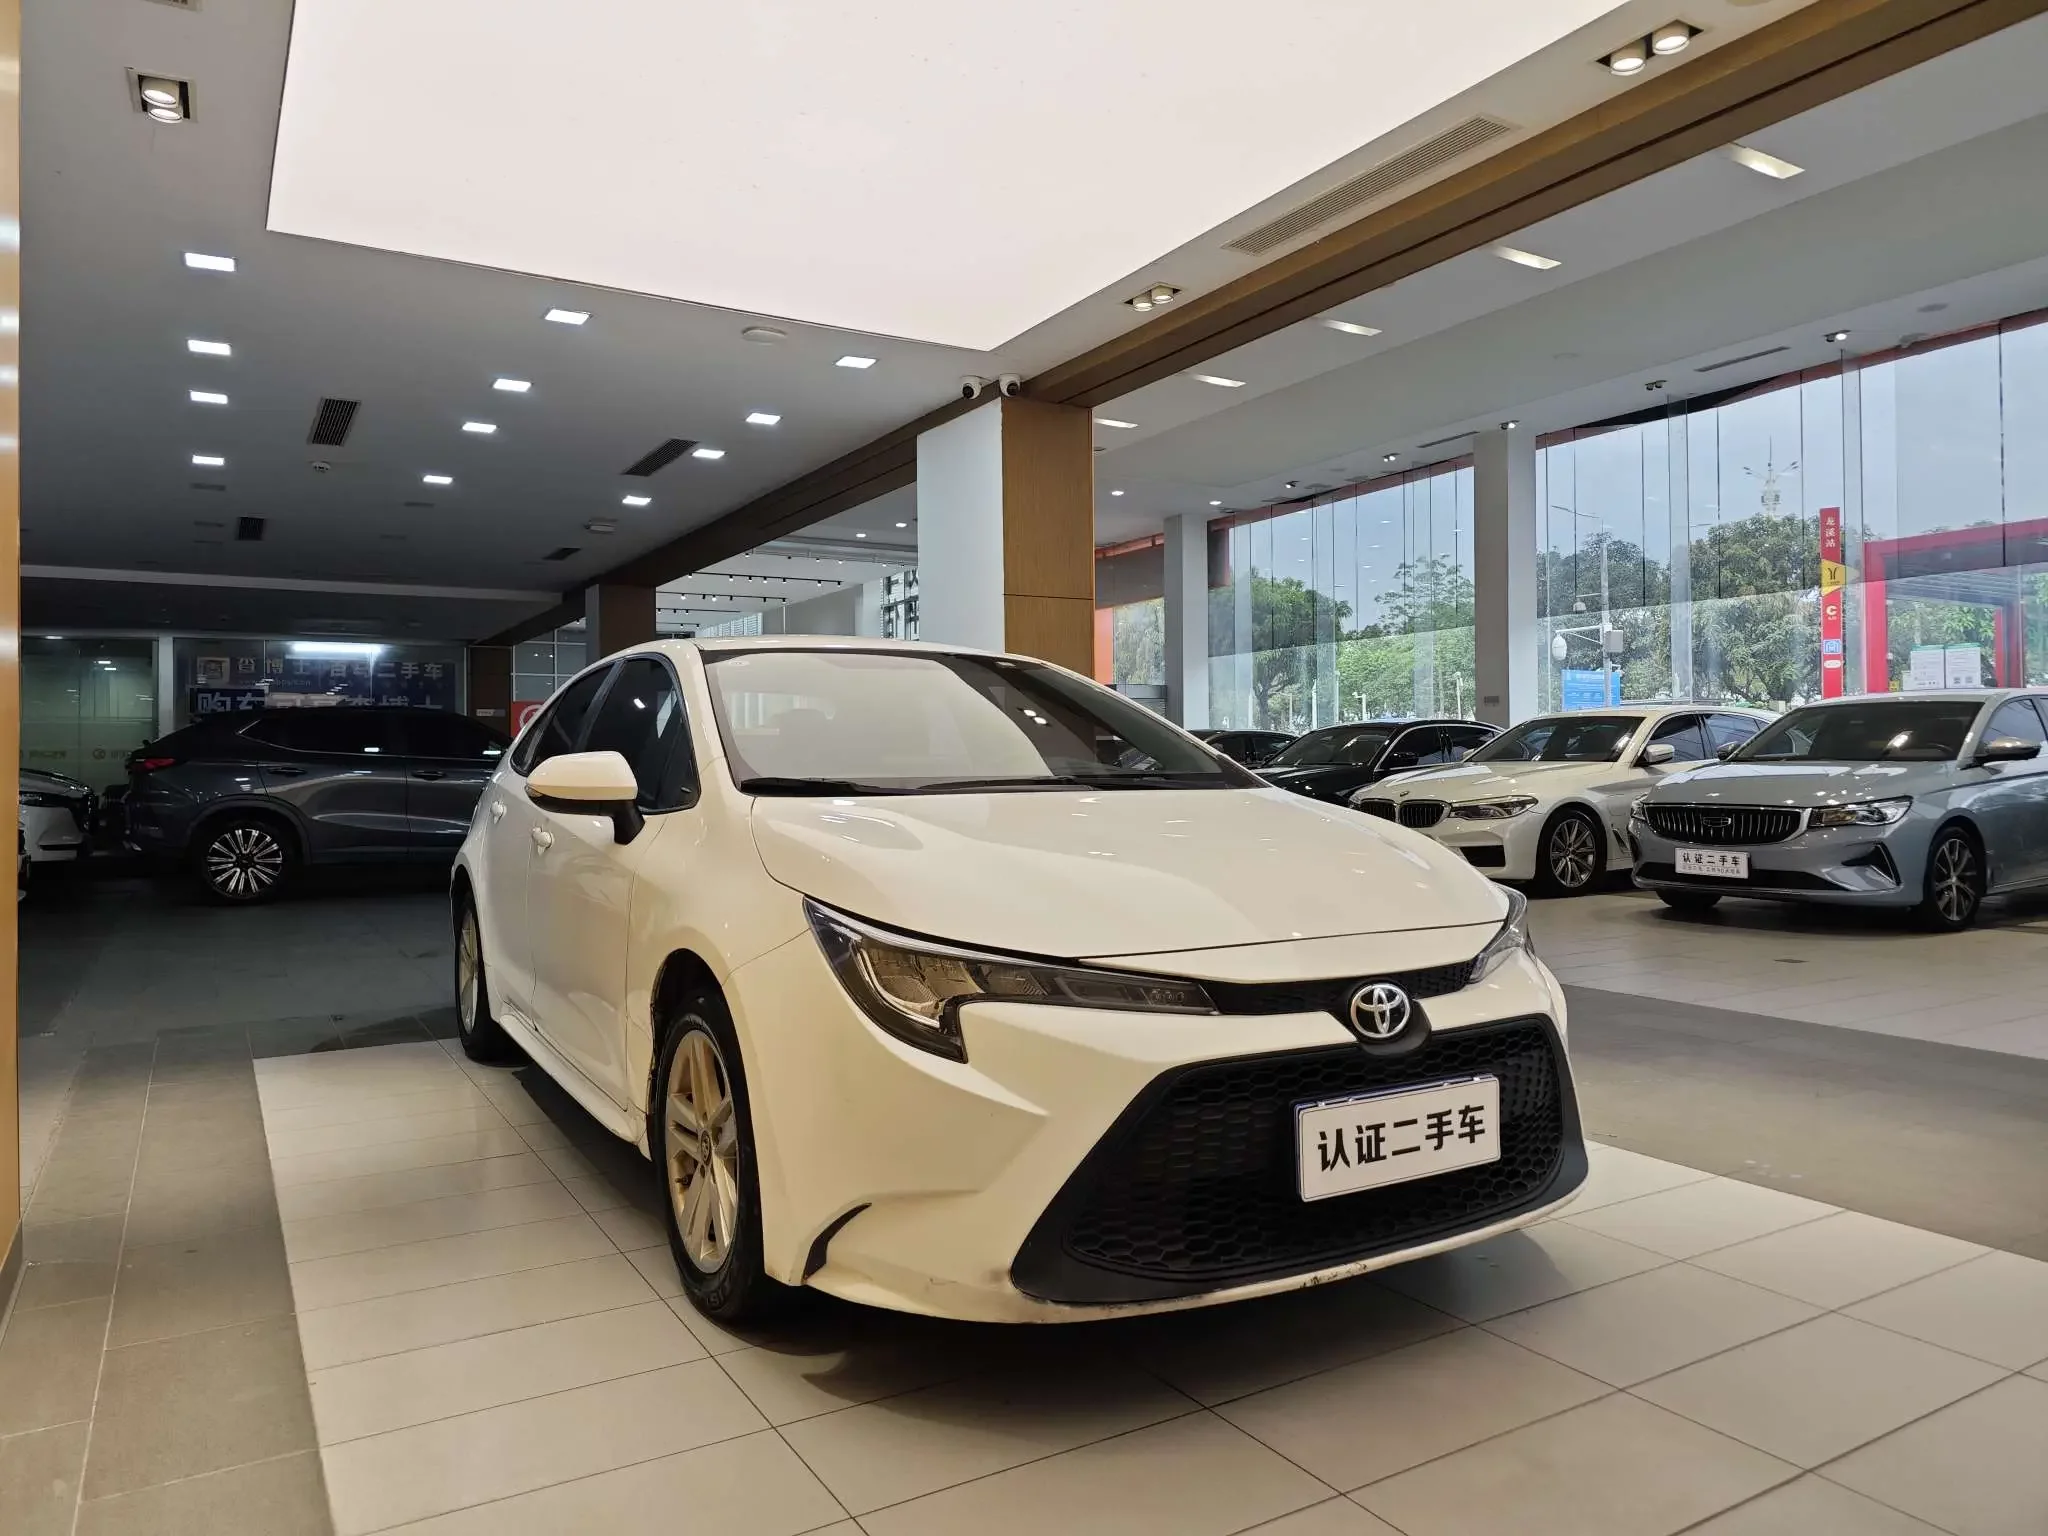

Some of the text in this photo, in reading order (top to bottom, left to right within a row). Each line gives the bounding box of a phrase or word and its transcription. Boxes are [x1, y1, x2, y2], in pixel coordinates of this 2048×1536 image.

[1826, 605, 1837, 616] C
[1683, 852, 1741, 866] 认证二手车
[1317, 1104, 1486, 1171] 认证二手车
